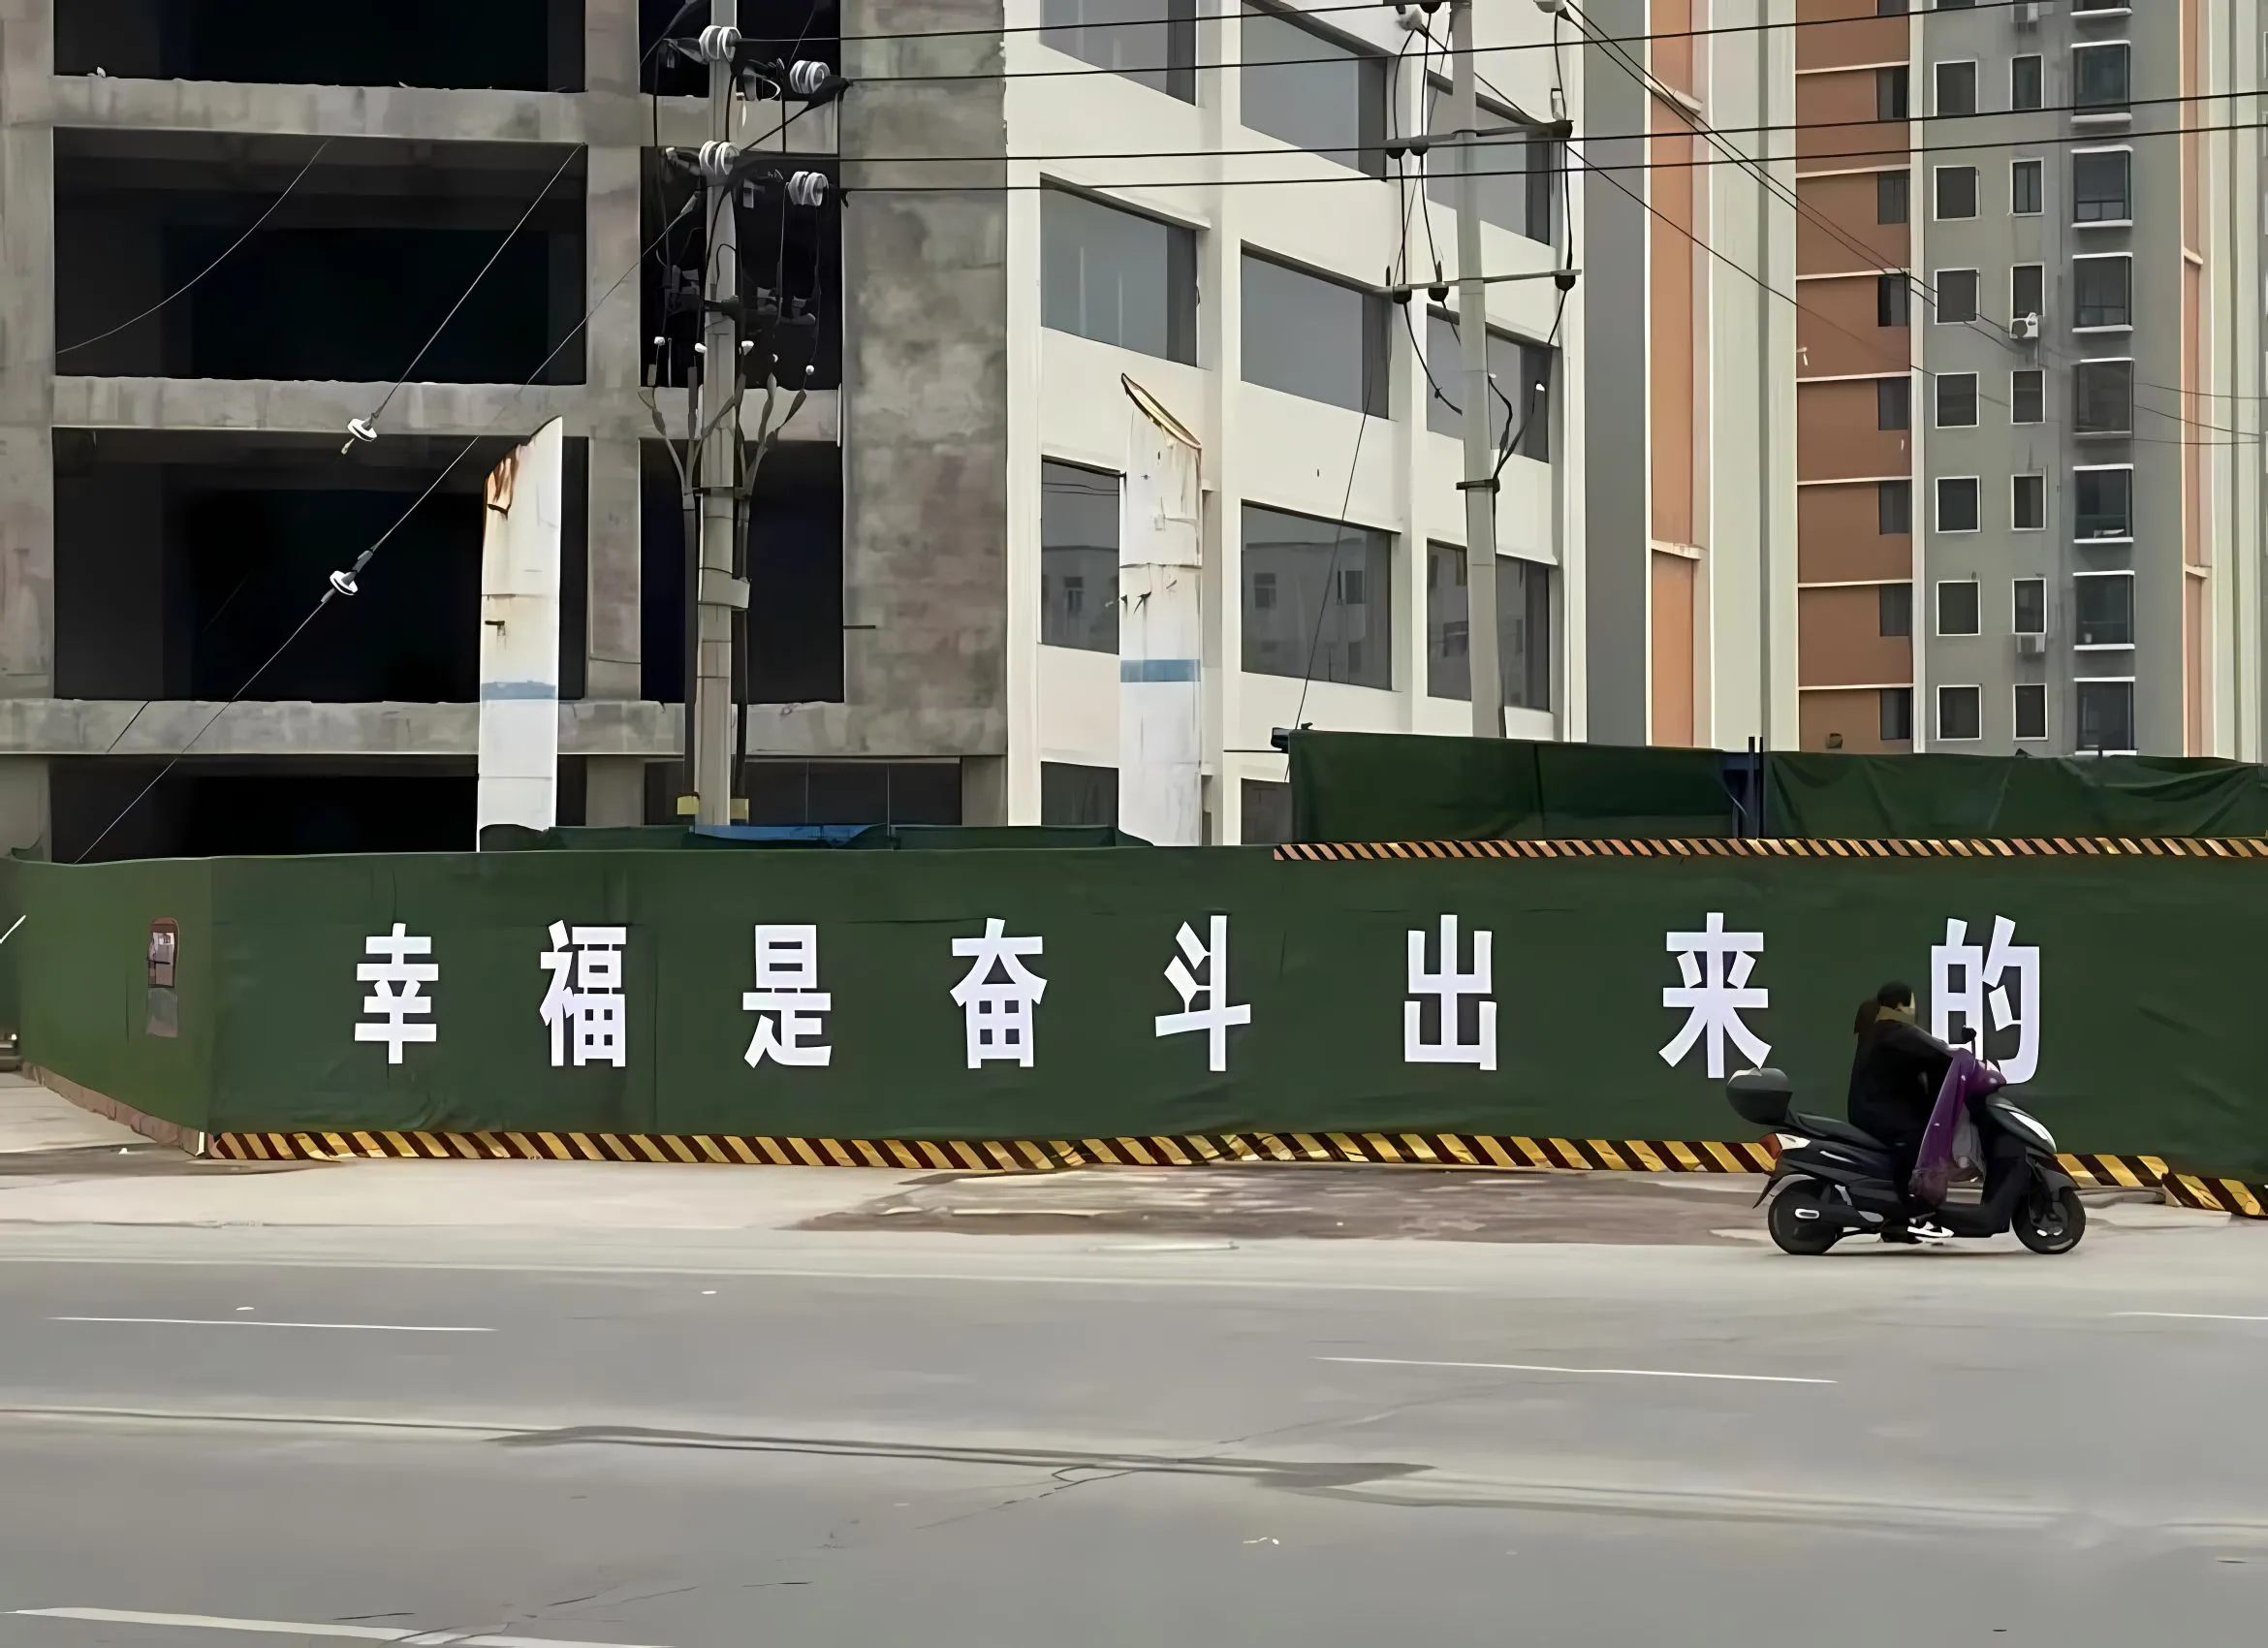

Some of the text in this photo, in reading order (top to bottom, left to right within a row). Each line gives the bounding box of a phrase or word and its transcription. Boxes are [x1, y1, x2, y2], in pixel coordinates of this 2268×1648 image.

[355, 912, 2040, 1084] 幸福是奋斗出来的
